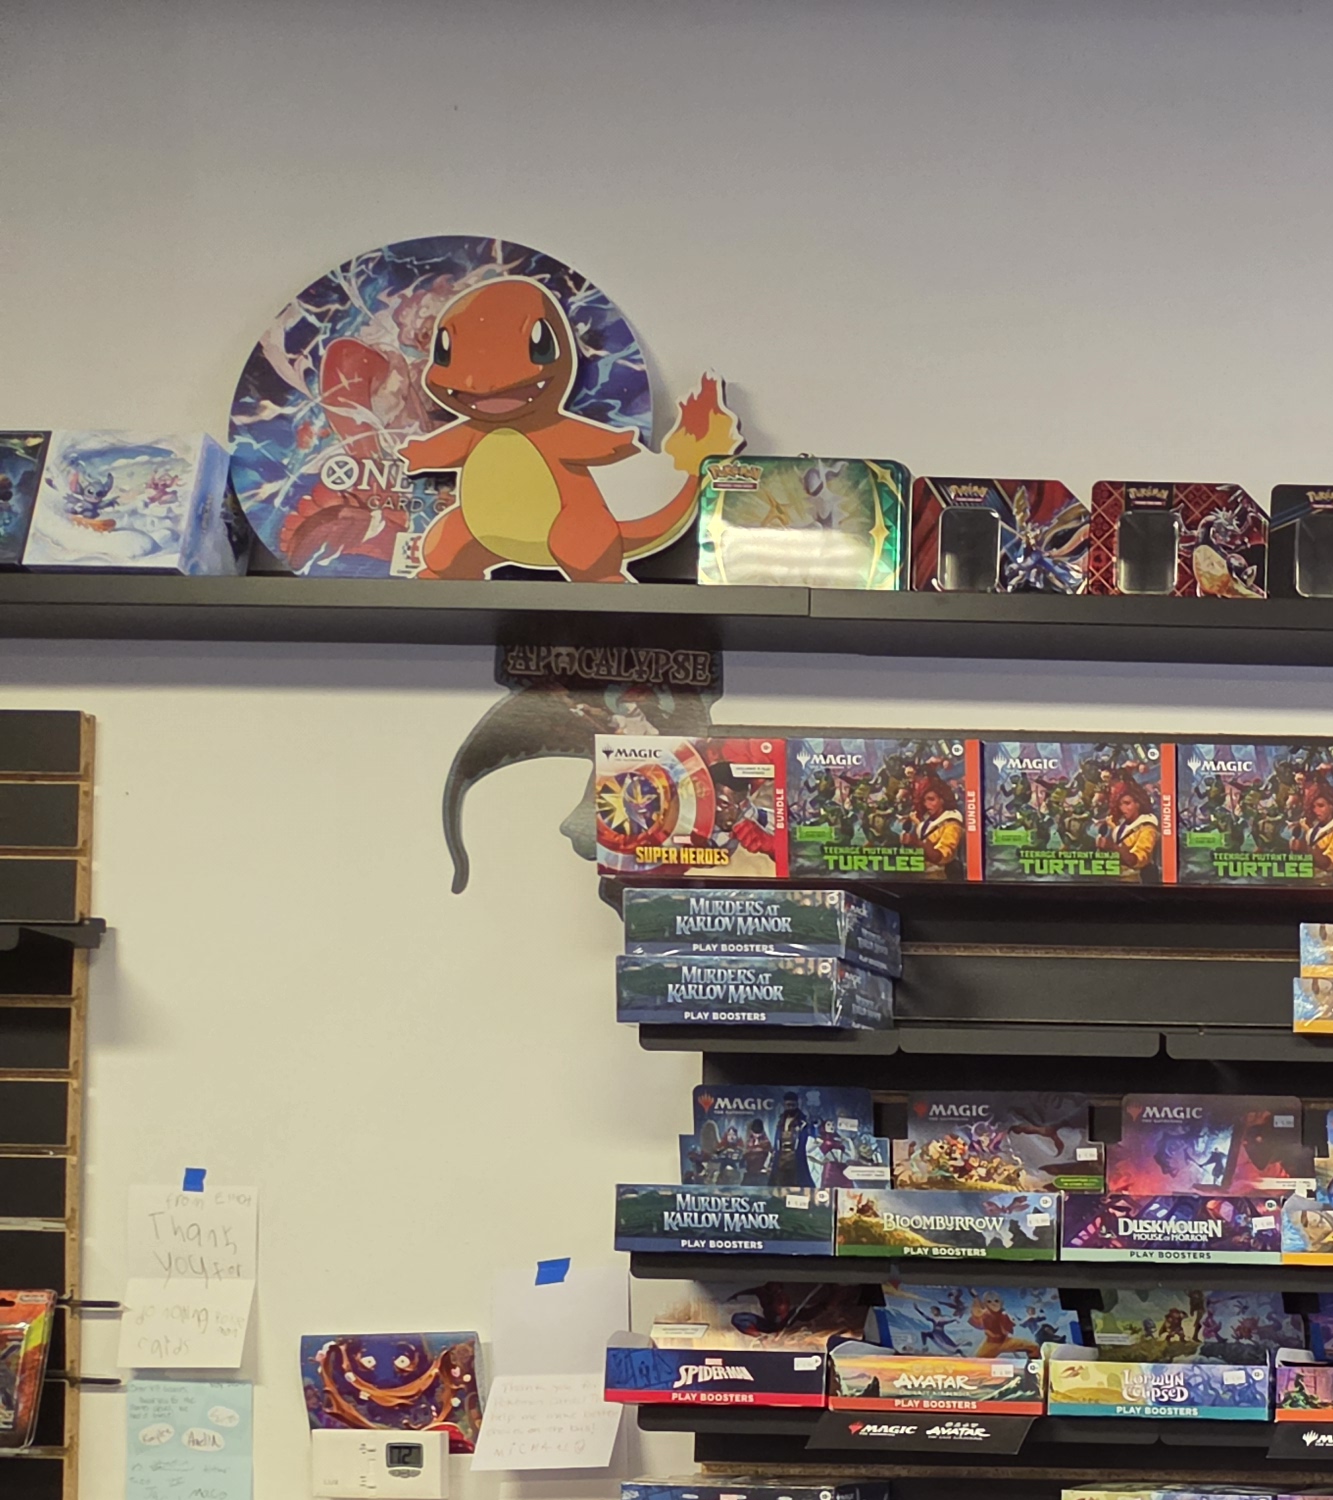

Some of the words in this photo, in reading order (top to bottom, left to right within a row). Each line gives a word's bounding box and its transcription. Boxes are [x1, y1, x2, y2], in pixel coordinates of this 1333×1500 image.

[615, 747, 662, 759] MAGIC
[776, 788, 785, 829] BUNDLE
[636, 846, 679, 866] SUPER
[681, 847, 729, 866] HEROES
[823, 846, 859, 855] TEENAGE
[862, 846, 897, 856] MUTANT
[899, 847, 925, 856] NINJA
[823, 854, 925, 872] TURTLES
[689, 898, 761, 917] MURDERS
[763, 904, 780, 916] AT
[675, 915, 735, 935] KARLOV
[736, 915, 793, 934] MANOR
[692, 943, 720, 952] PLAY
[722, 943, 775, 953] BOOSTERS
[883, 1212, 1004, 1234] BLOOMBURROW
[1118, 1217, 1223, 1238] DUSKMOURN
